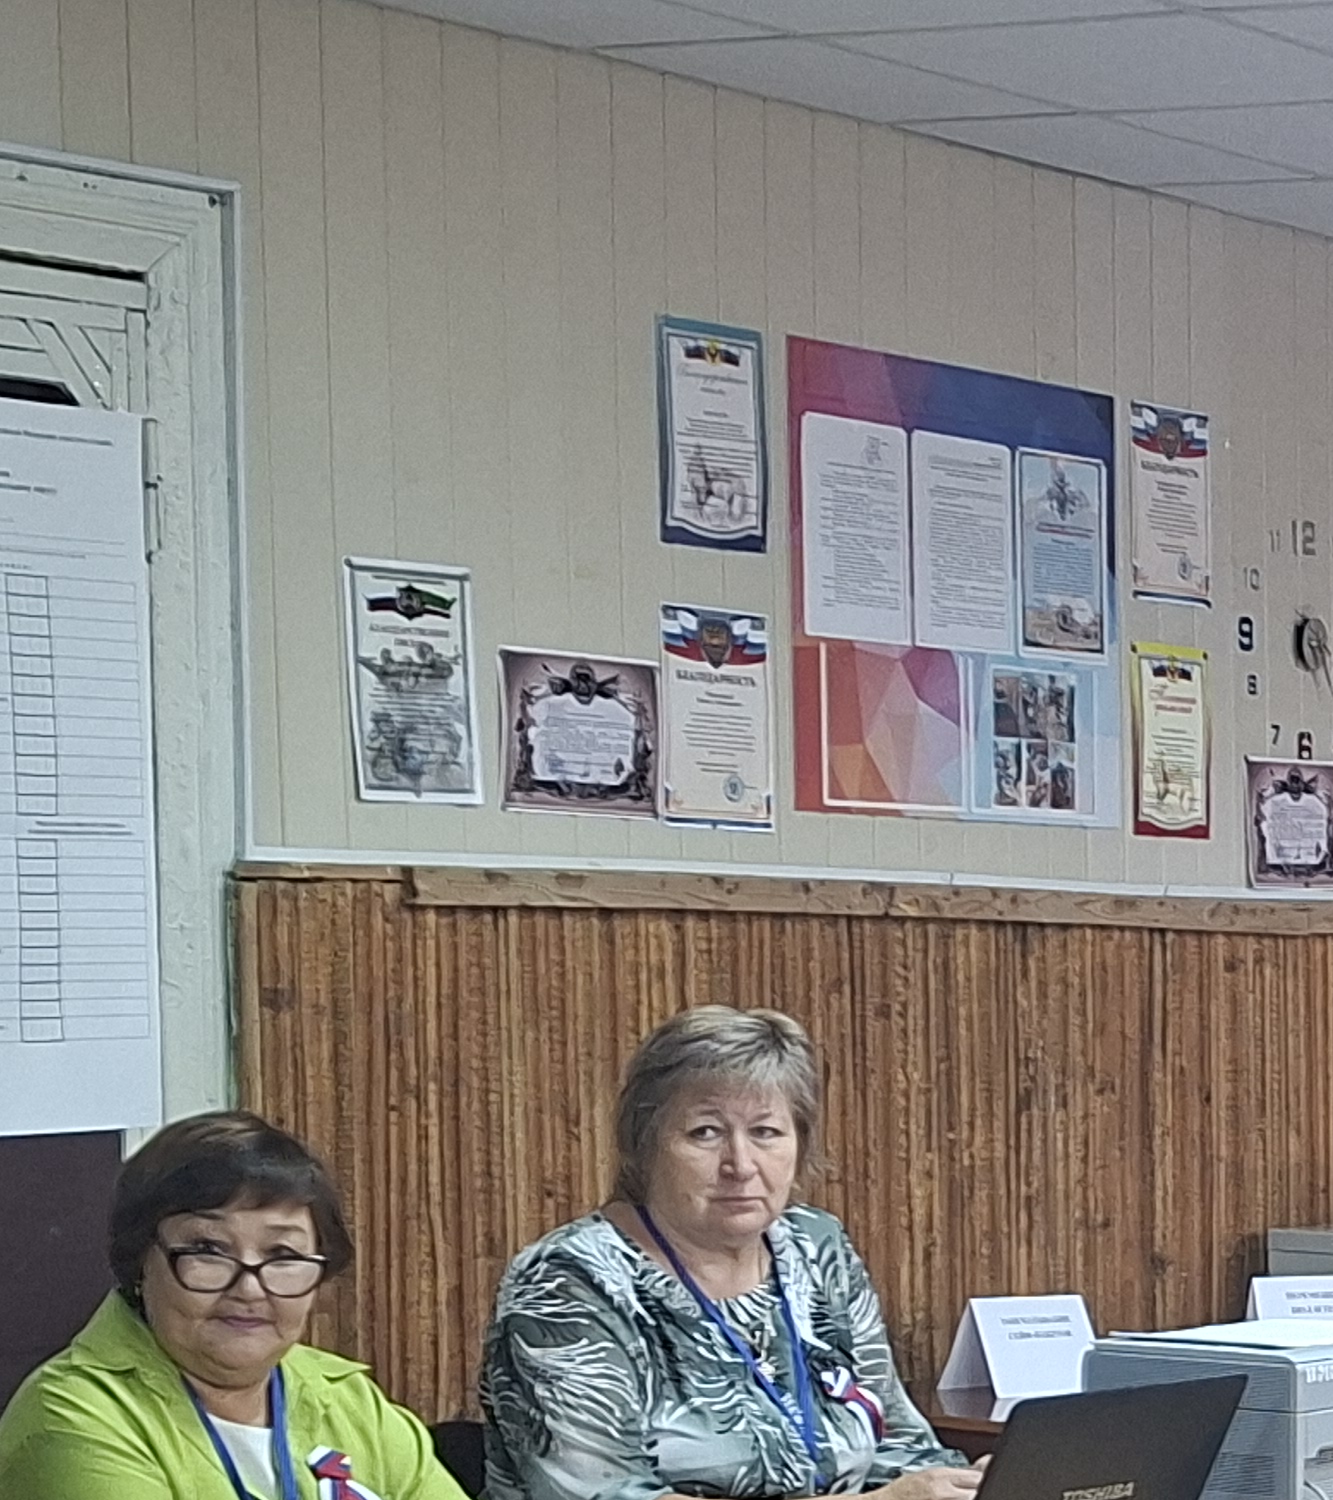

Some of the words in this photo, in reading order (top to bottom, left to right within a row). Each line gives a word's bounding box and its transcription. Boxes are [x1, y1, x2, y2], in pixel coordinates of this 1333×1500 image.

[1291, 519, 1316, 556] 12
[1244, 566, 1260, 591] 10
[1238, 616, 1254, 651] 9
[1271, 724, 1280, 745] 7
[1297, 732, 1312, 759] 6
